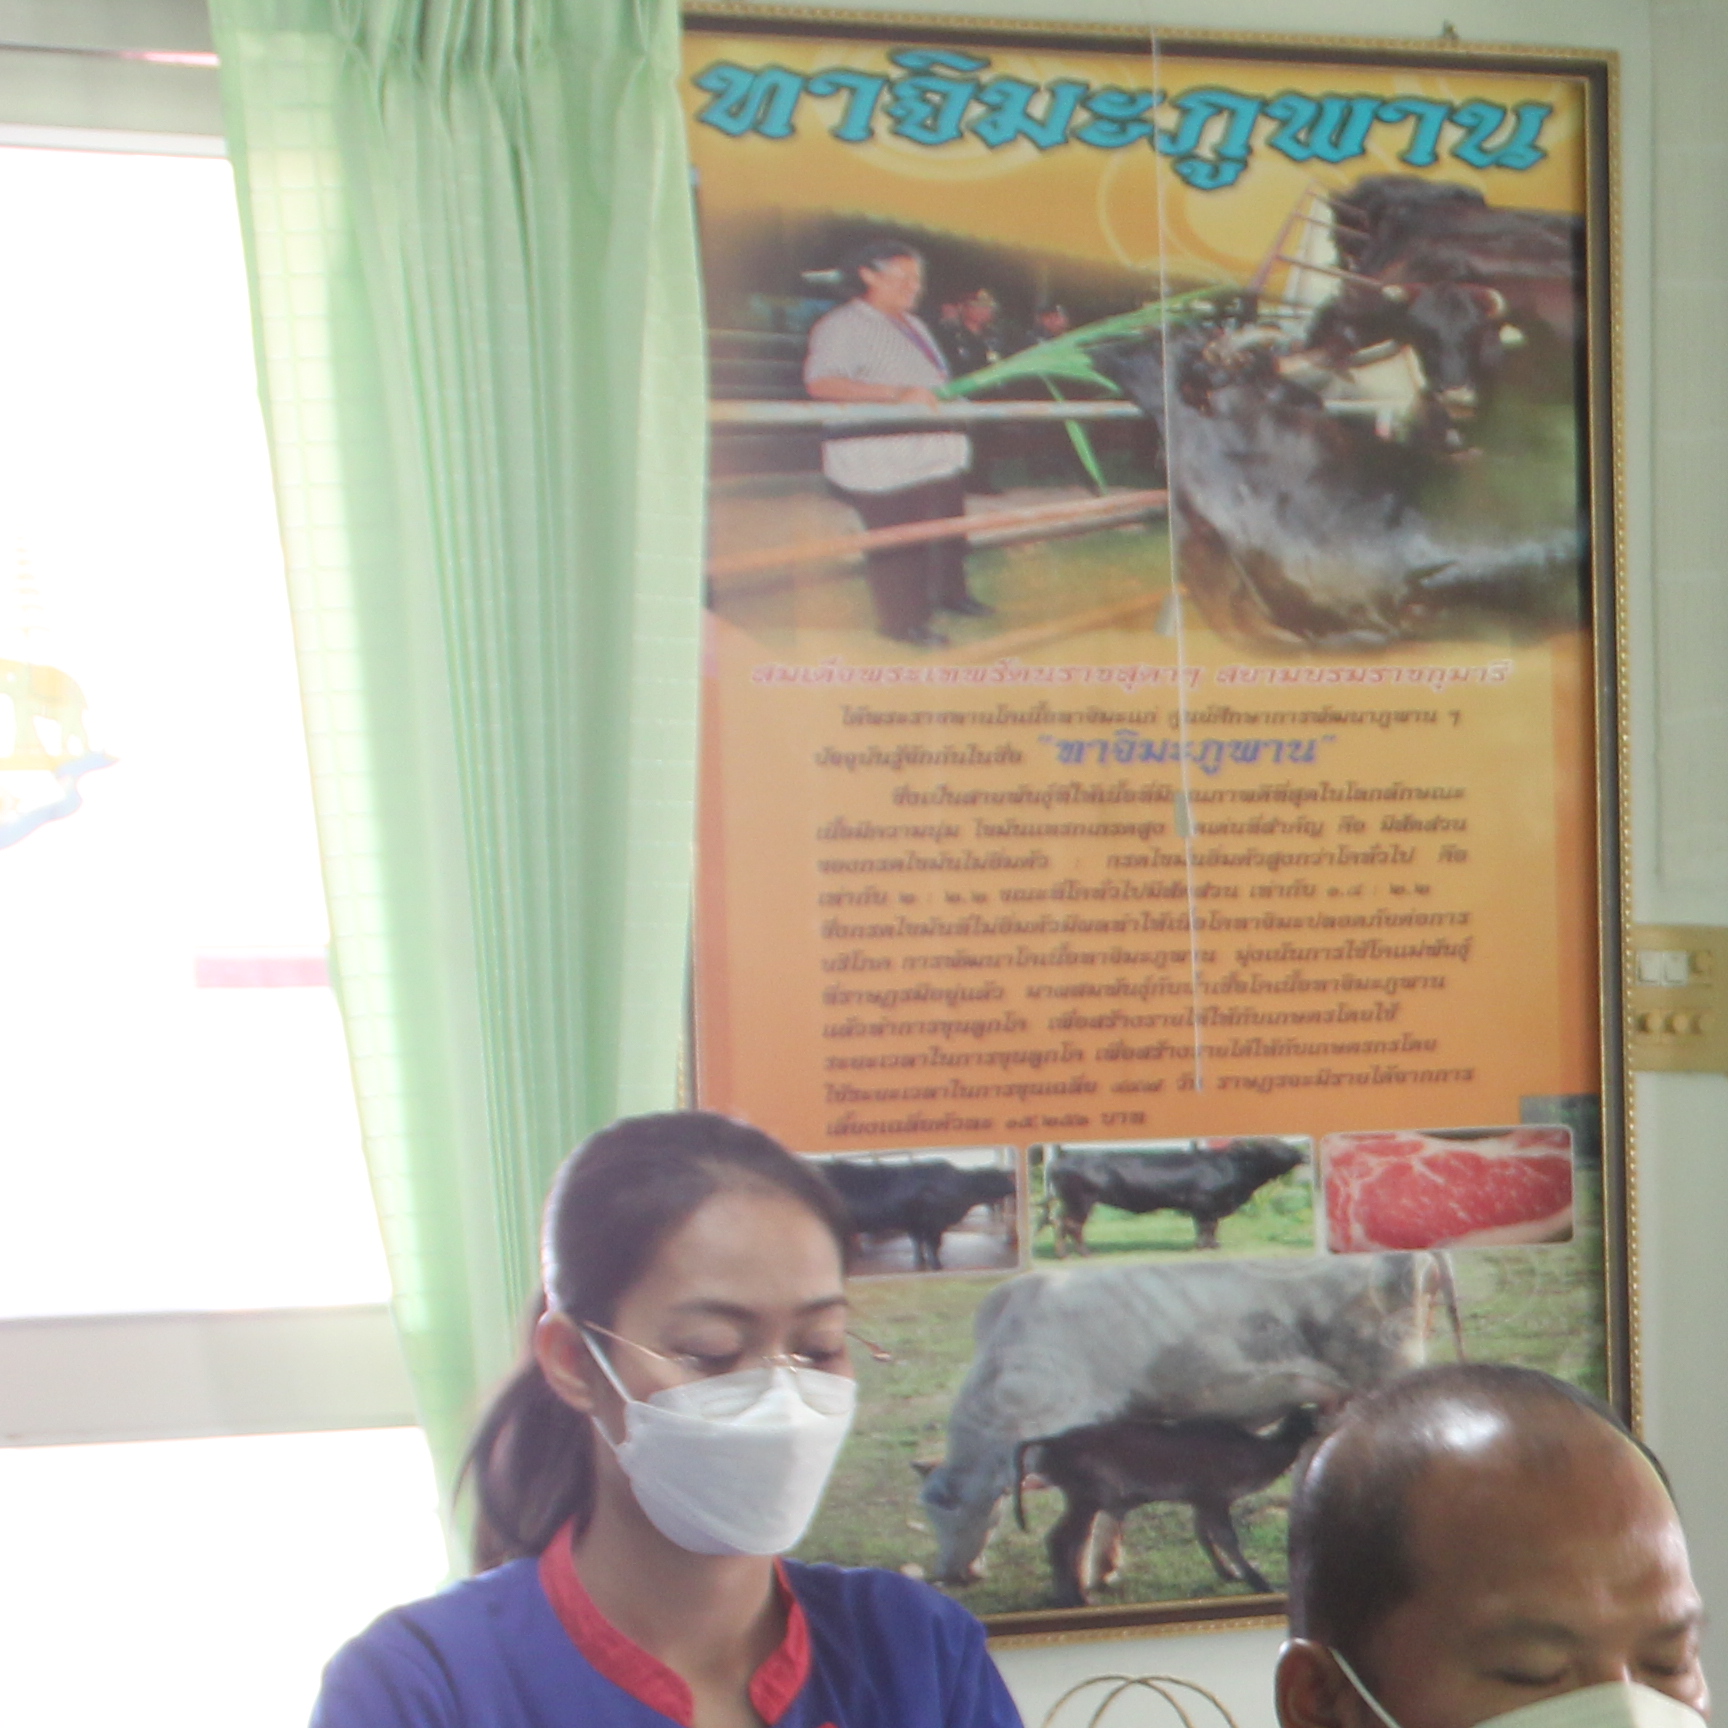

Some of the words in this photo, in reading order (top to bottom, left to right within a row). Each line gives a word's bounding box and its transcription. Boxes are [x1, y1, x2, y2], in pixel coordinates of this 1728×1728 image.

[690, 46, 1555, 191] ทาจิมะภูพาน
